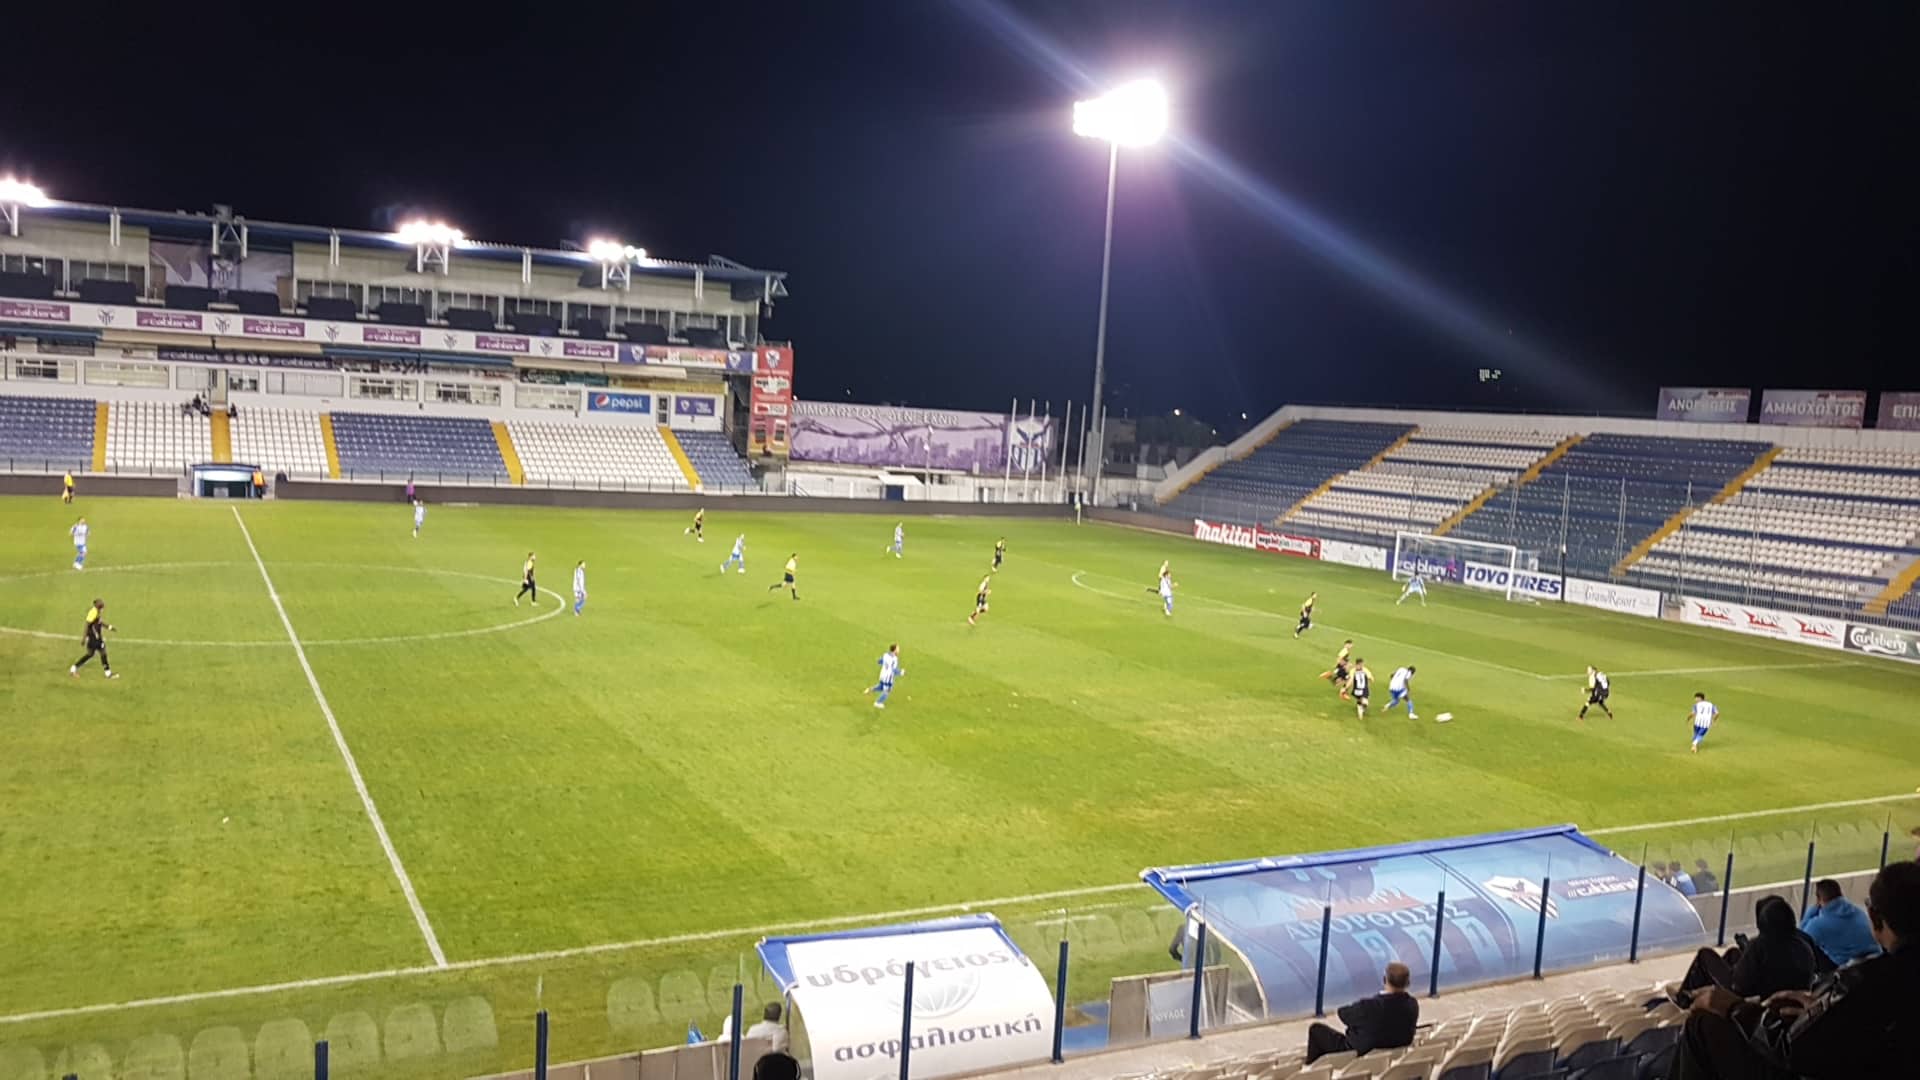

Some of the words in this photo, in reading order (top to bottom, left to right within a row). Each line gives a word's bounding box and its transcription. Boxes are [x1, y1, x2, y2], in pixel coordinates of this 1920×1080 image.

[611, 395, 643, 410] pepsi
[1467, 566, 1509, 585] TOYO
[1511, 574, 1562, 594] TIRES
[1850, 627, 1907, 654] Carlsberg
[806, 950, 1009, 988] υδρόγειος
[834, 1012, 1042, 1063] ασφαλιστική
